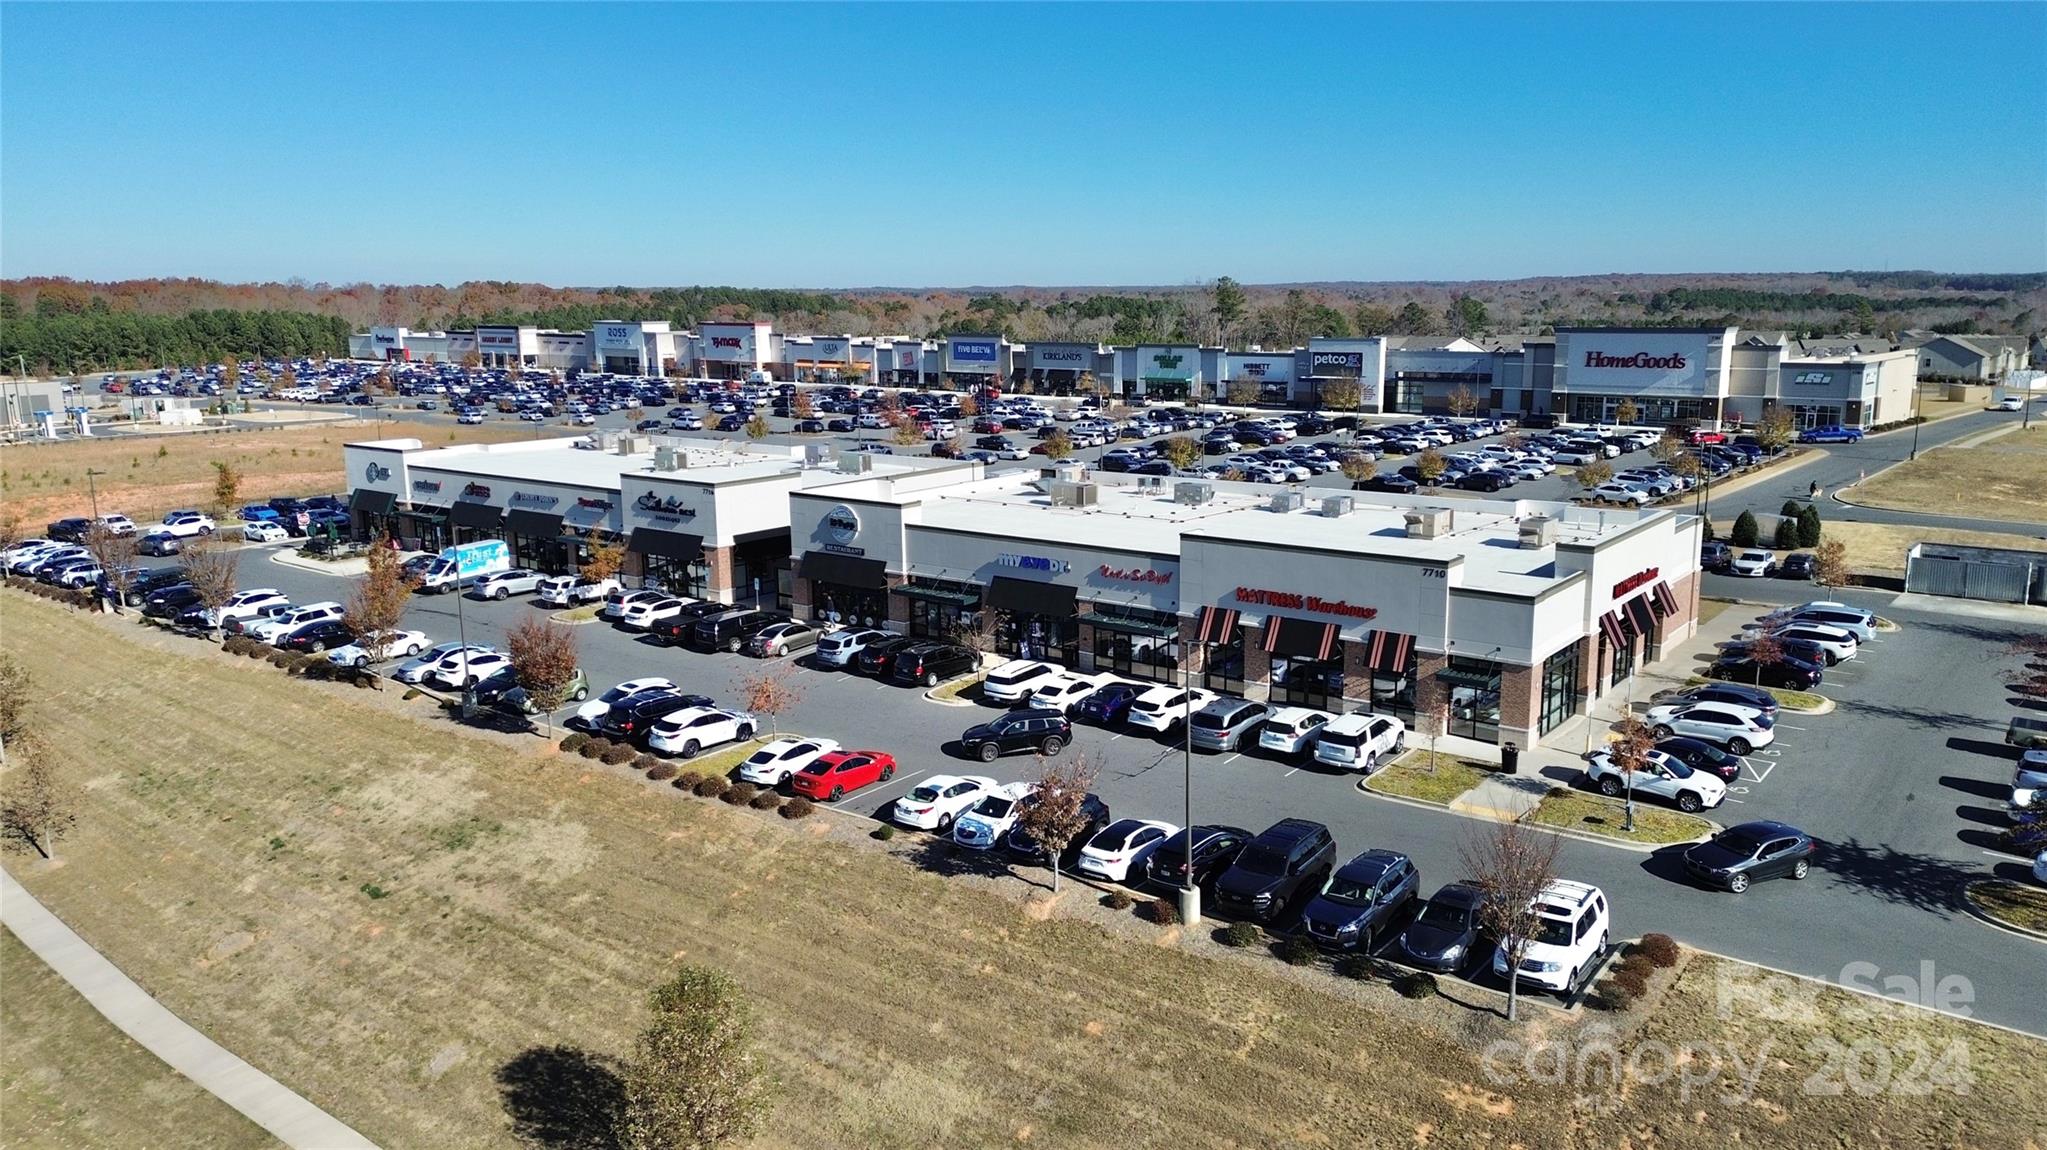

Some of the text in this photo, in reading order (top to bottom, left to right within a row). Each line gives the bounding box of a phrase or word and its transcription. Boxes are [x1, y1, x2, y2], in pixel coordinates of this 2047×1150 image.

[607, 327, 628, 338] ROSS
[1314, 354, 1347, 366] petco
[1584, 351, 1686, 369] HomeGoods
[1422, 567, 1446, 578] 7710
[1236, 586, 1378, 619] MATTRESS Warehouse
